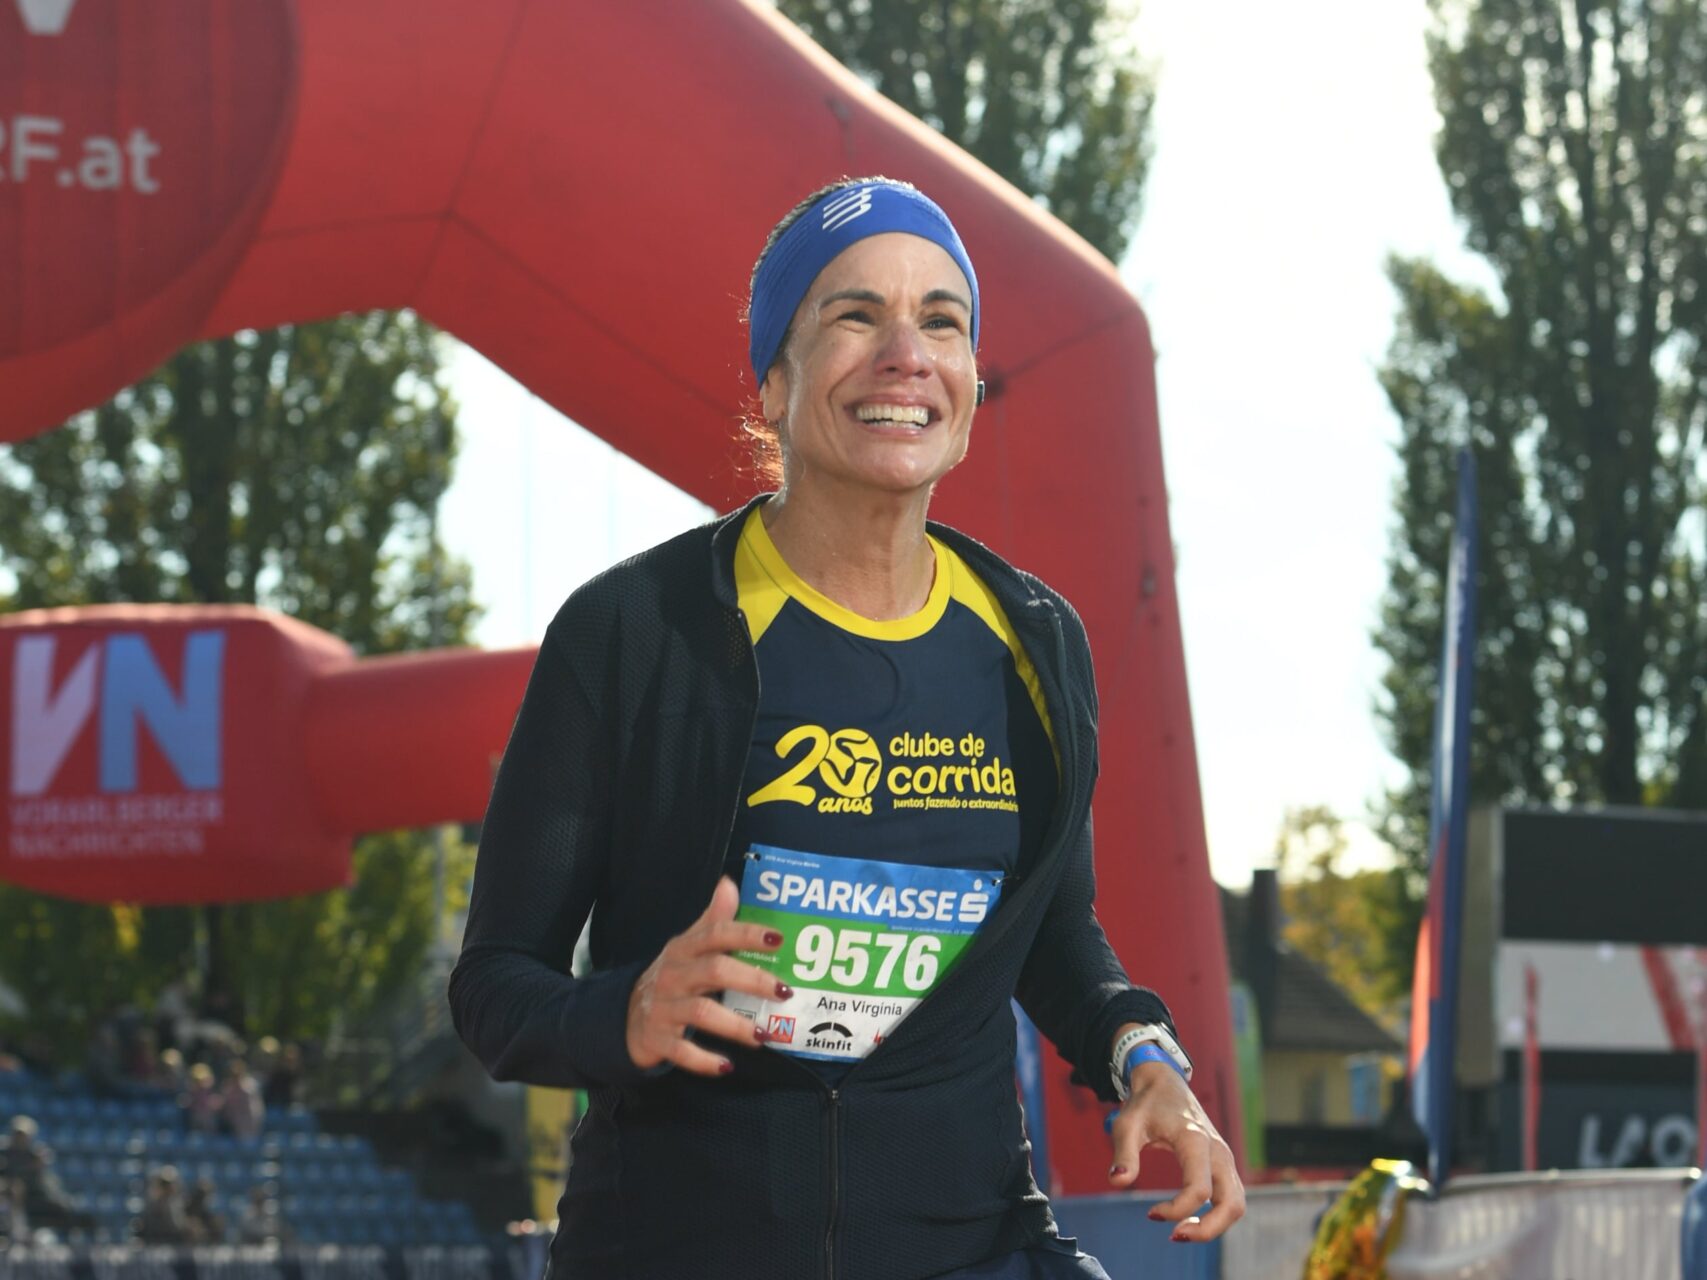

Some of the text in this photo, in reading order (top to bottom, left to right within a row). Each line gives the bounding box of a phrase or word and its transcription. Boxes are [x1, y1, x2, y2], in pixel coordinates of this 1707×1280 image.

[0, 116, 161, 195] F.at
[14, 631, 224, 794] VN
[889, 731, 985, 757] clube de
[886, 756, 1016, 796] corrida
[817, 796, 873, 815] anos
[924, 795, 960, 810] fazendo
[961, 799, 968, 808] o
[756, 870, 957, 922] SPARKASSE
[792, 924, 942, 991] 9576
[817, 996, 903, 1017] Ana Virginia
[805, 1037, 853, 1051] skinfit
